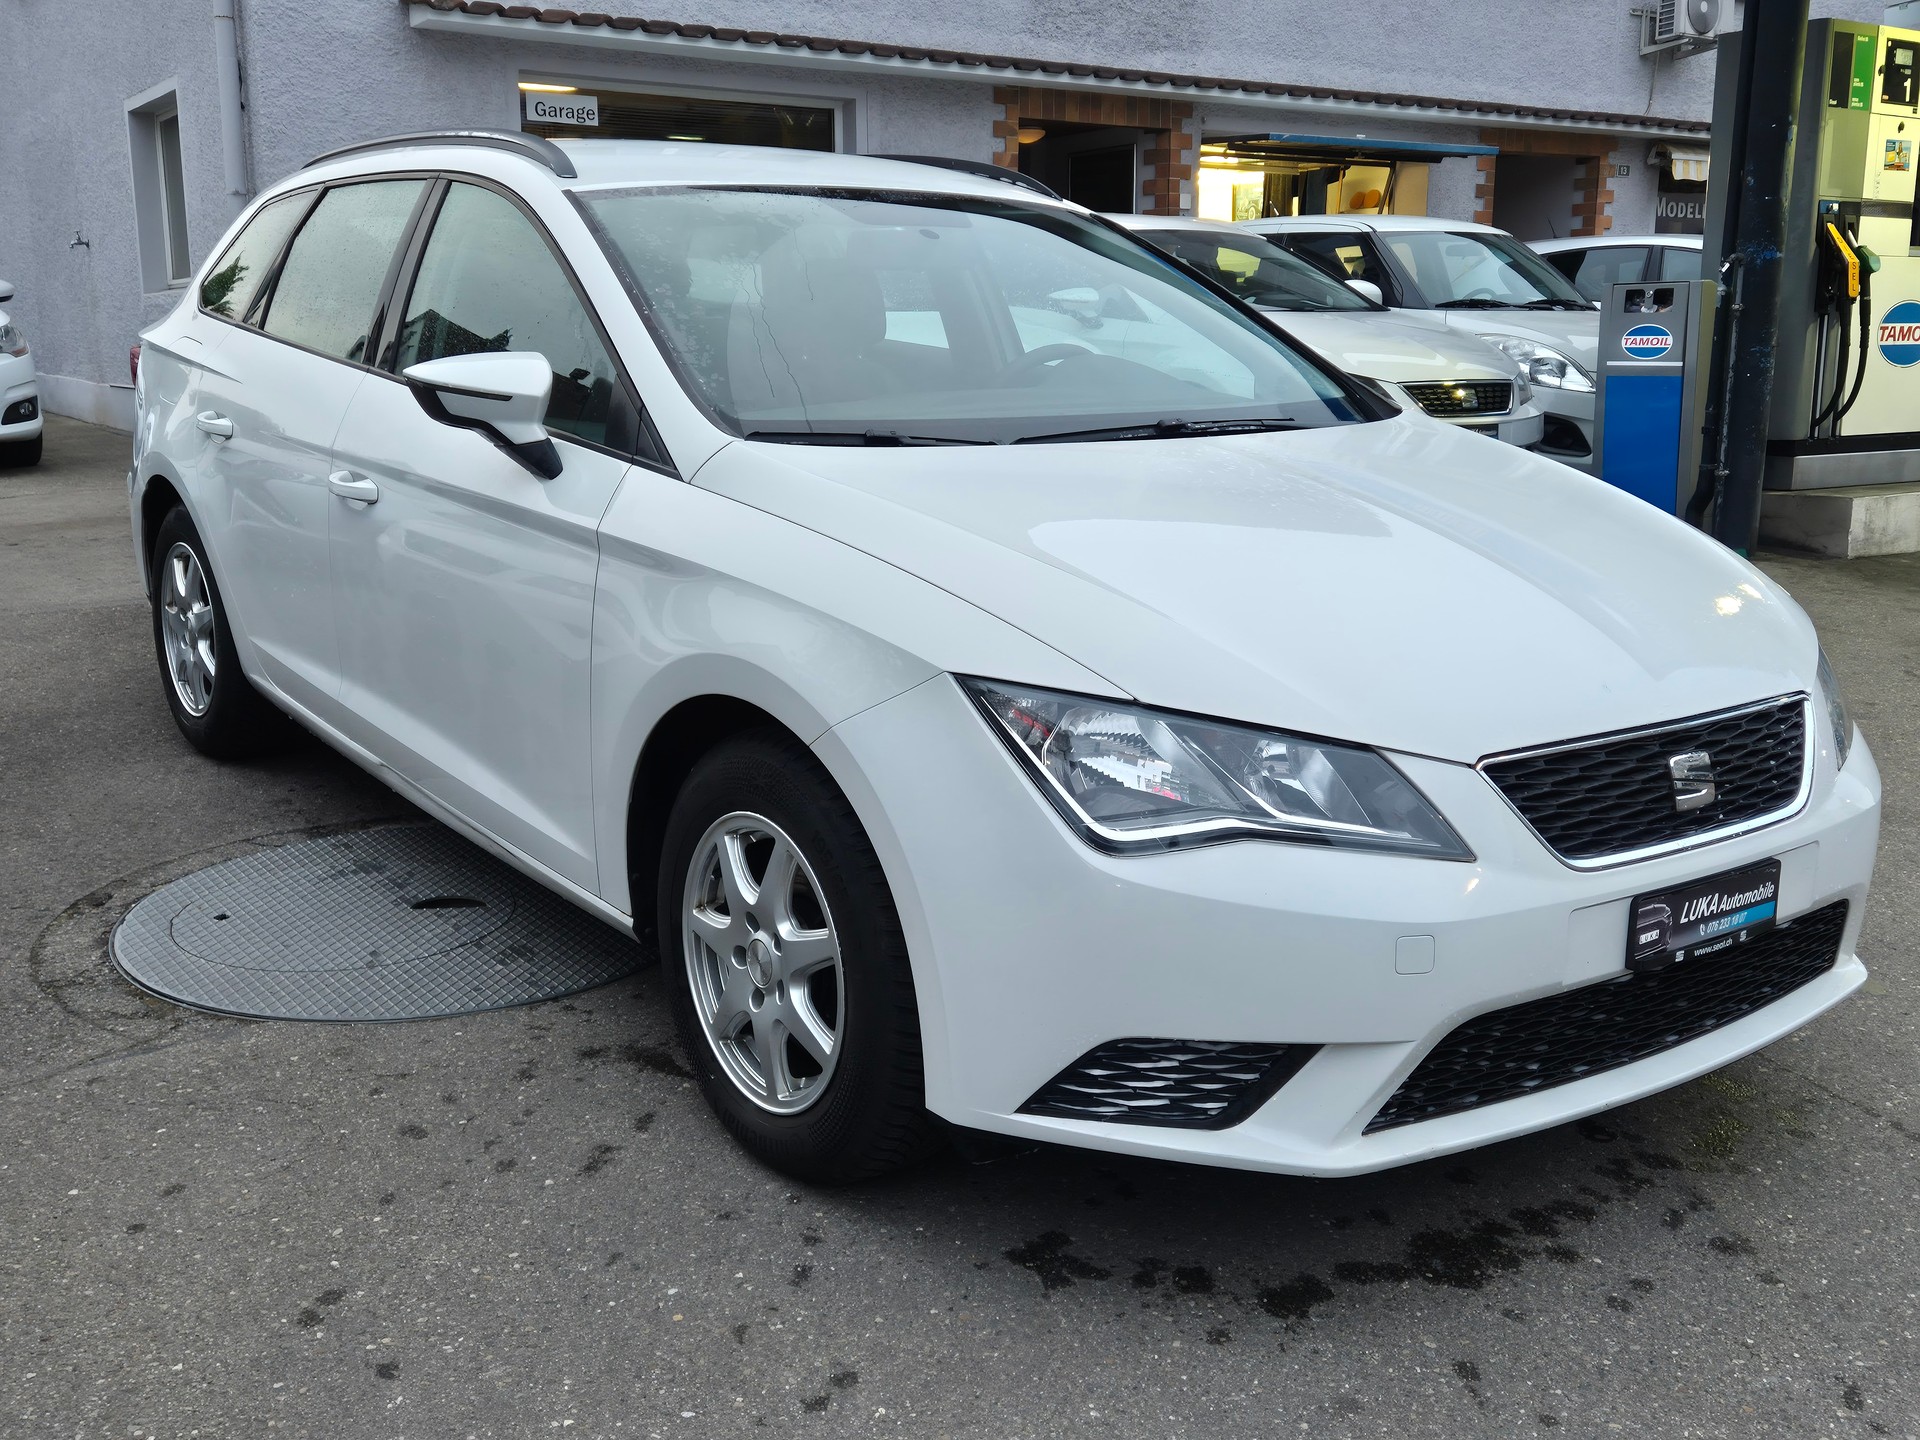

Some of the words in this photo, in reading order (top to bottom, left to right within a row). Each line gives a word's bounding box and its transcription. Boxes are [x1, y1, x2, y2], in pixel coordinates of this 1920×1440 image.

[1903, 78, 1912, 102] 1
[534, 101, 596, 123] Garage
[1620, 166, 1628, 175] 13
[1623, 337, 1671, 346] TAMOIL
[1680, 893, 1719, 924] LUKA
[1718, 881, 1775, 912] Automobile
[1707, 920, 1719, 933] 076
[1719, 917, 1731, 930] 233
[1694, 937, 1733, 957] www.seat.ch
